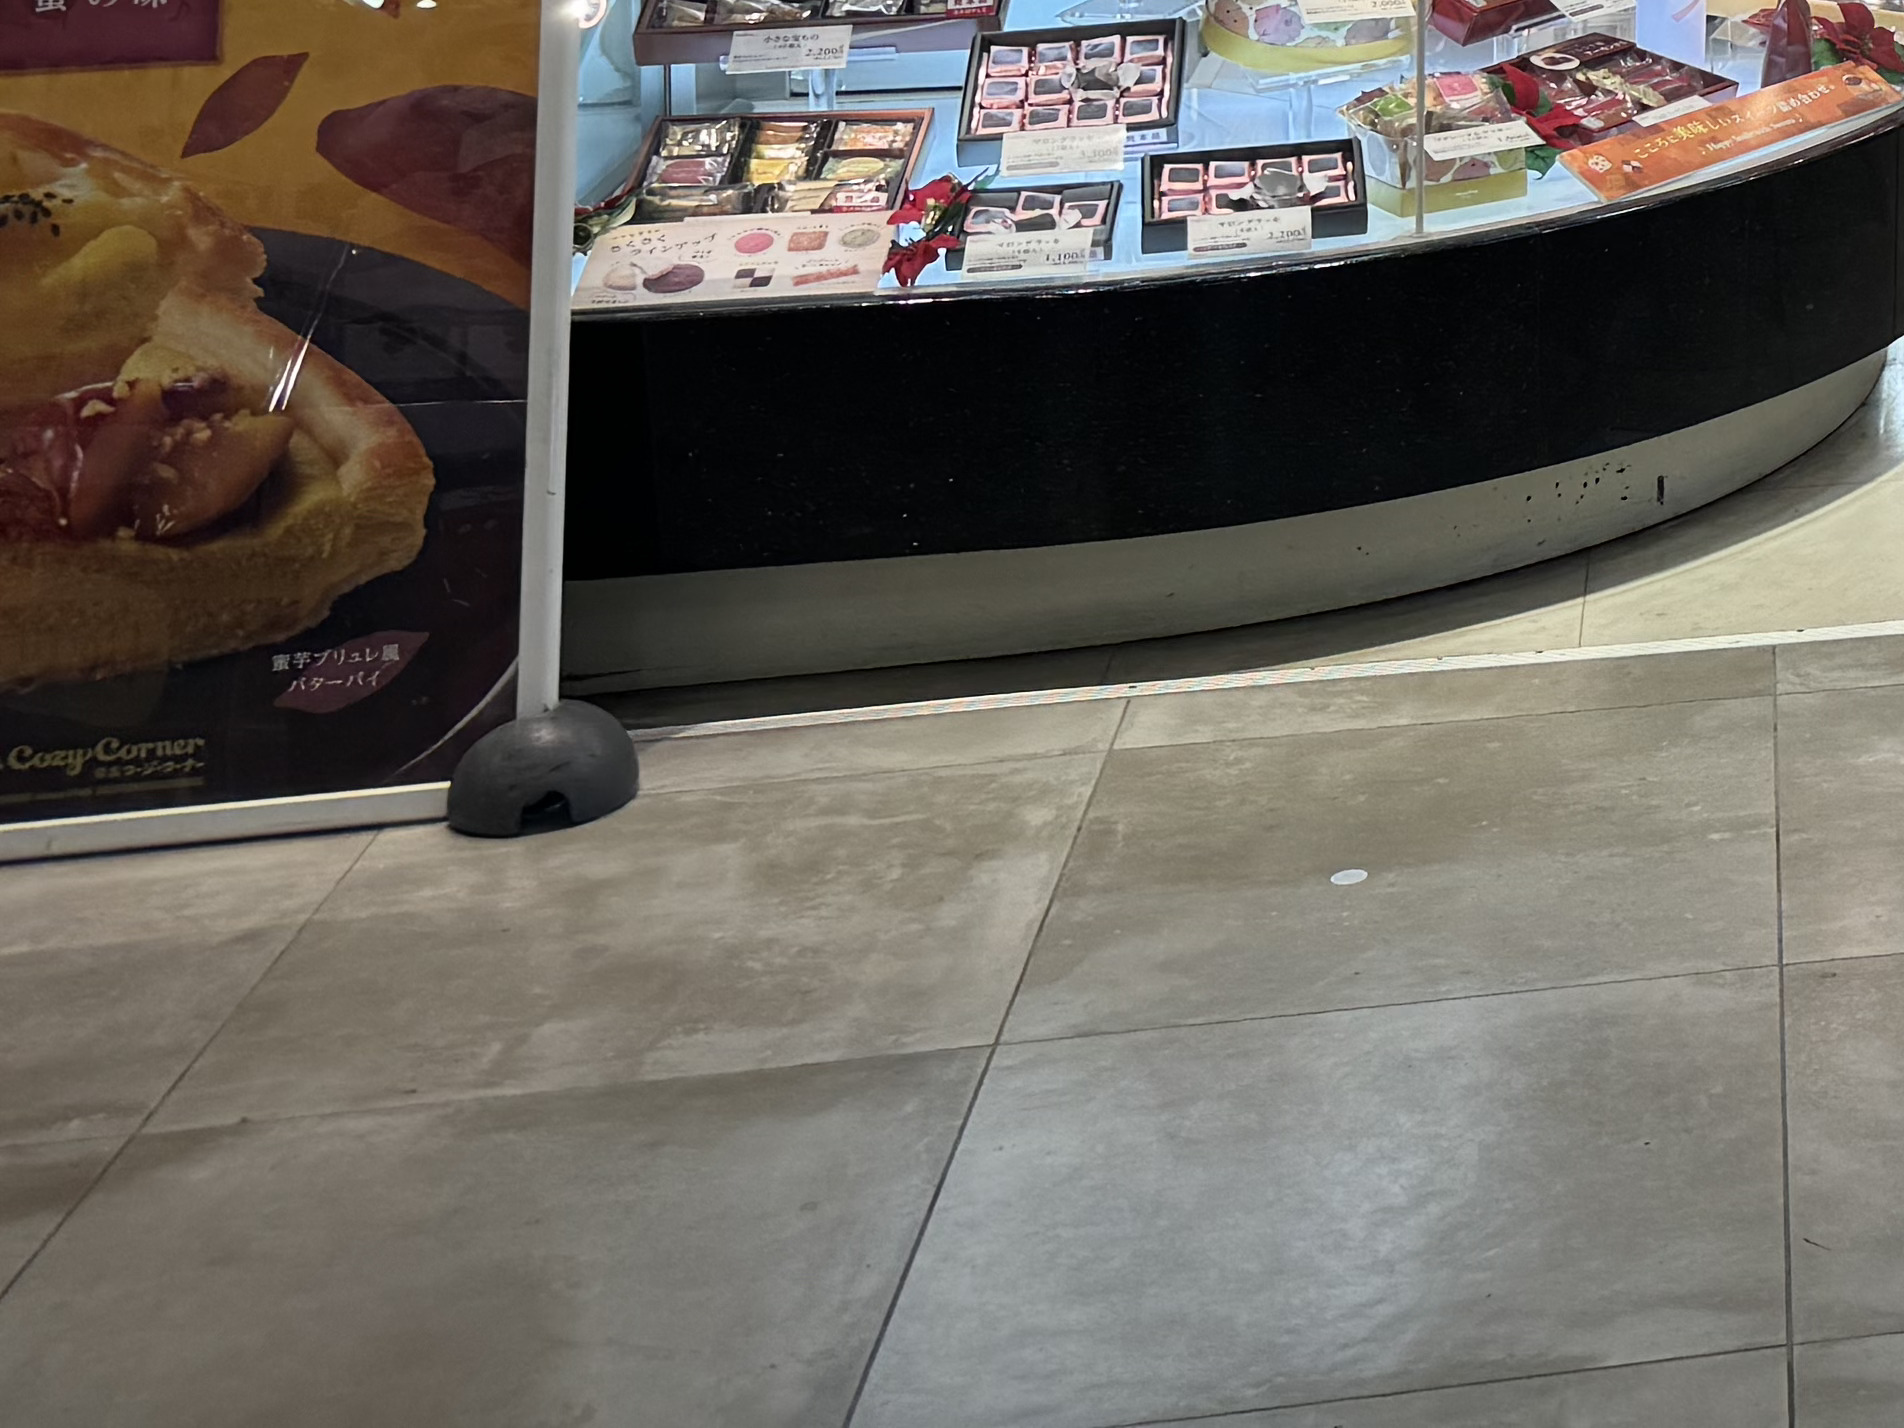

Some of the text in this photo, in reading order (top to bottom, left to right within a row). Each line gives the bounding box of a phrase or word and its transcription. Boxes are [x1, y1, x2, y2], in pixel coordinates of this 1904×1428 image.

[288, 671, 380, 692] バターパイ
[7, 737, 206, 776] Cozy Corner
